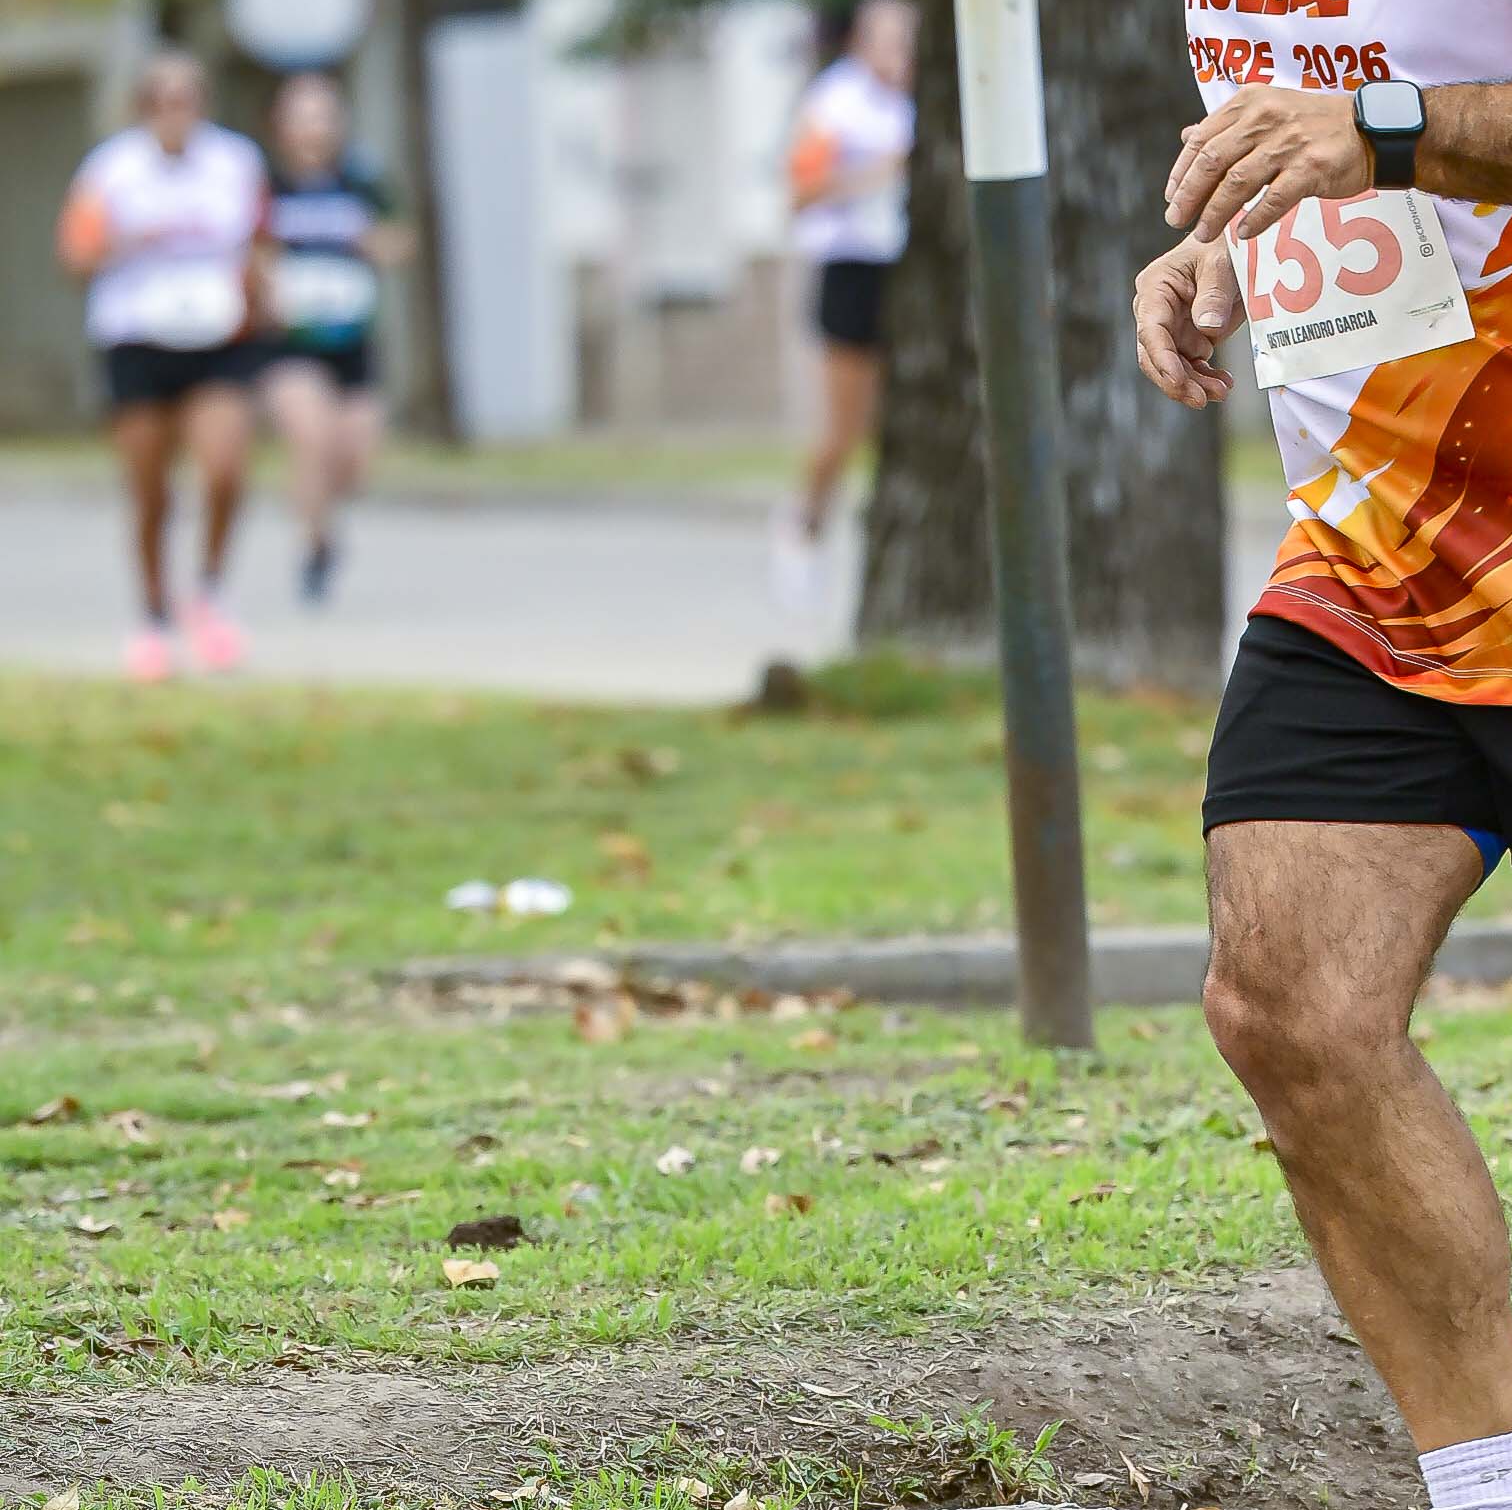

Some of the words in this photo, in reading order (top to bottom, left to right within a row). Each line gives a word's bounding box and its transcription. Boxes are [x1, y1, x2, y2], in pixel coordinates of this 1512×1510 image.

[1188, 37, 1275, 84] ORRE
[1293, 42, 1390, 91] 2026
[1290, 319, 1335, 345] LEANDRO
[1334, 309, 1378, 334] GARCIA
